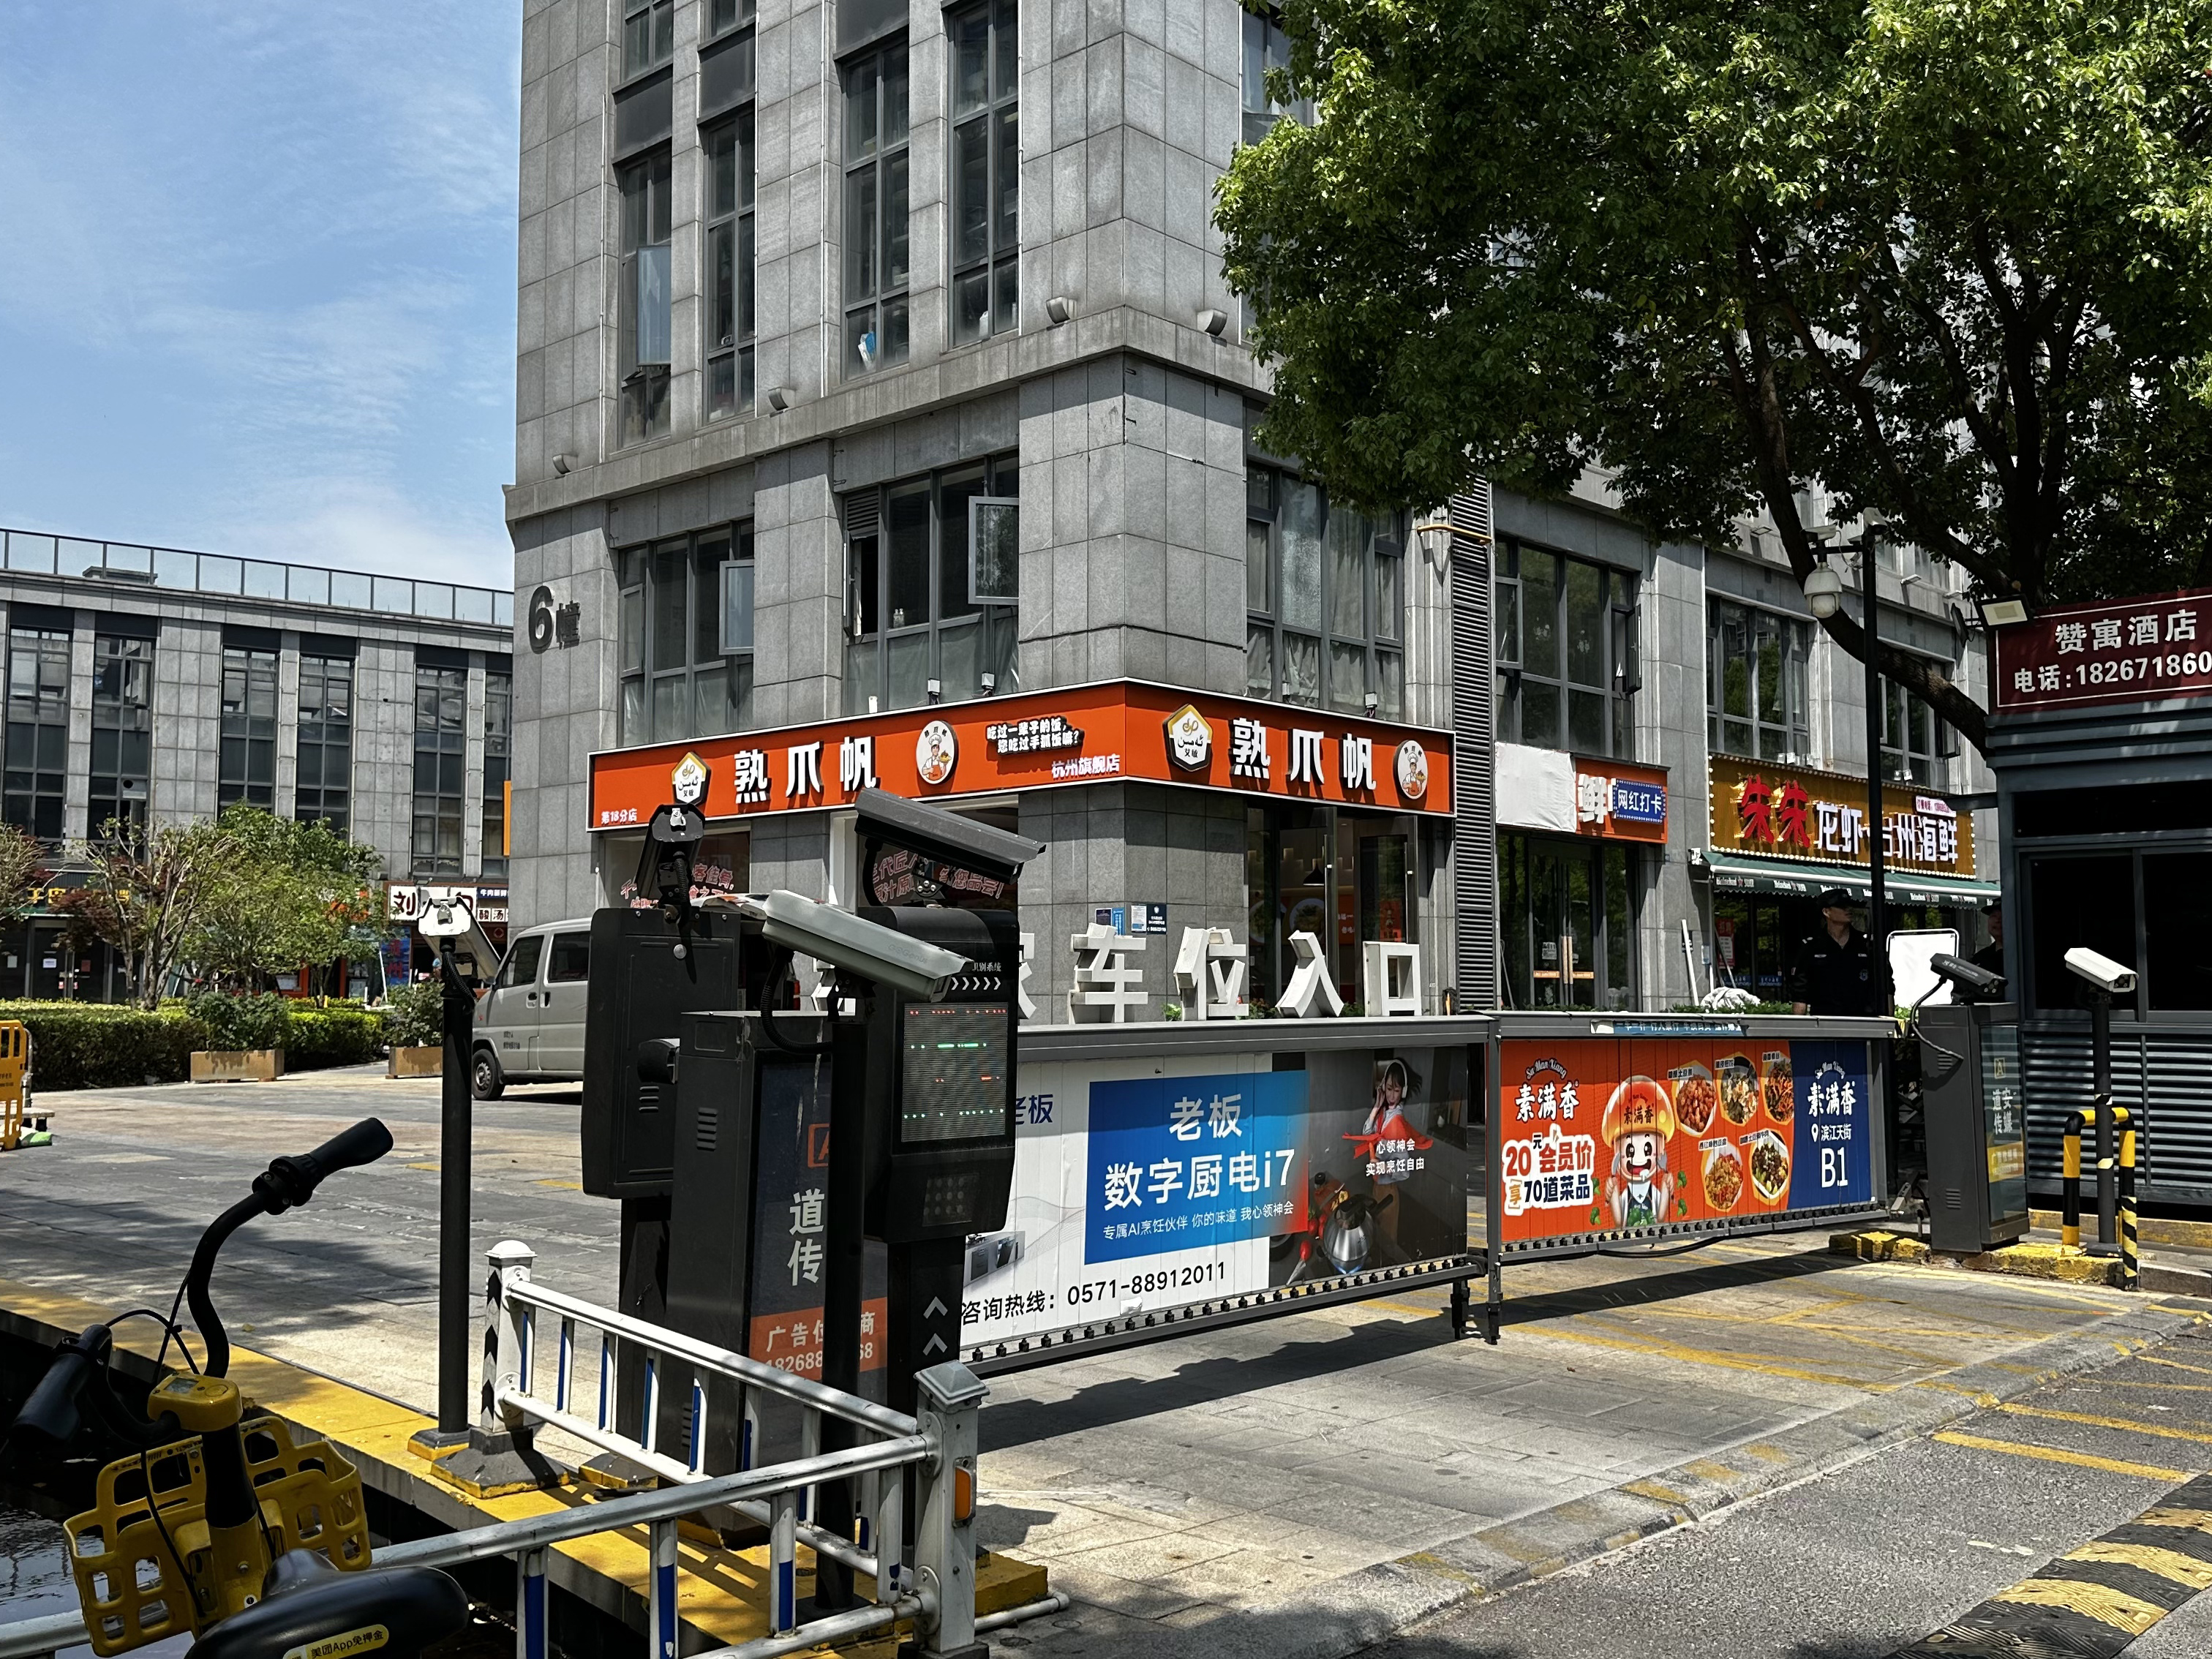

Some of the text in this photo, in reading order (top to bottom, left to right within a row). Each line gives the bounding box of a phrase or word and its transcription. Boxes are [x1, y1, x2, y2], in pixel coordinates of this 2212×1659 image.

[2055, 609, 2197, 655] 赞寓酒店
[734, 736, 876, 804] 熟爪帆
[1051, 753, 1121, 778] 杭州旗舰店
[1233, 718, 1376, 790] 熟爪帆
[1618, 789, 1662, 814] 网红打卡
[1169, 1093, 1243, 1141] 老板
[1515, 1082, 1579, 1122] 素满香
[1807, 1081, 1856, 1117] 素满香
[1376, 1138, 1415, 1154] 心领神会
[1821, 1124, 1851, 1141] 滨江天街
[1104, 1149, 1295, 1211] 数字厨电i7
[1366, 1157, 1424, 1177] 实现烹饪自由
[1821, 1146, 1848, 1188] B1
[1103, 1201, 1294, 1240] 专属AI烹饪伙伴 你的味道 我心领神会
